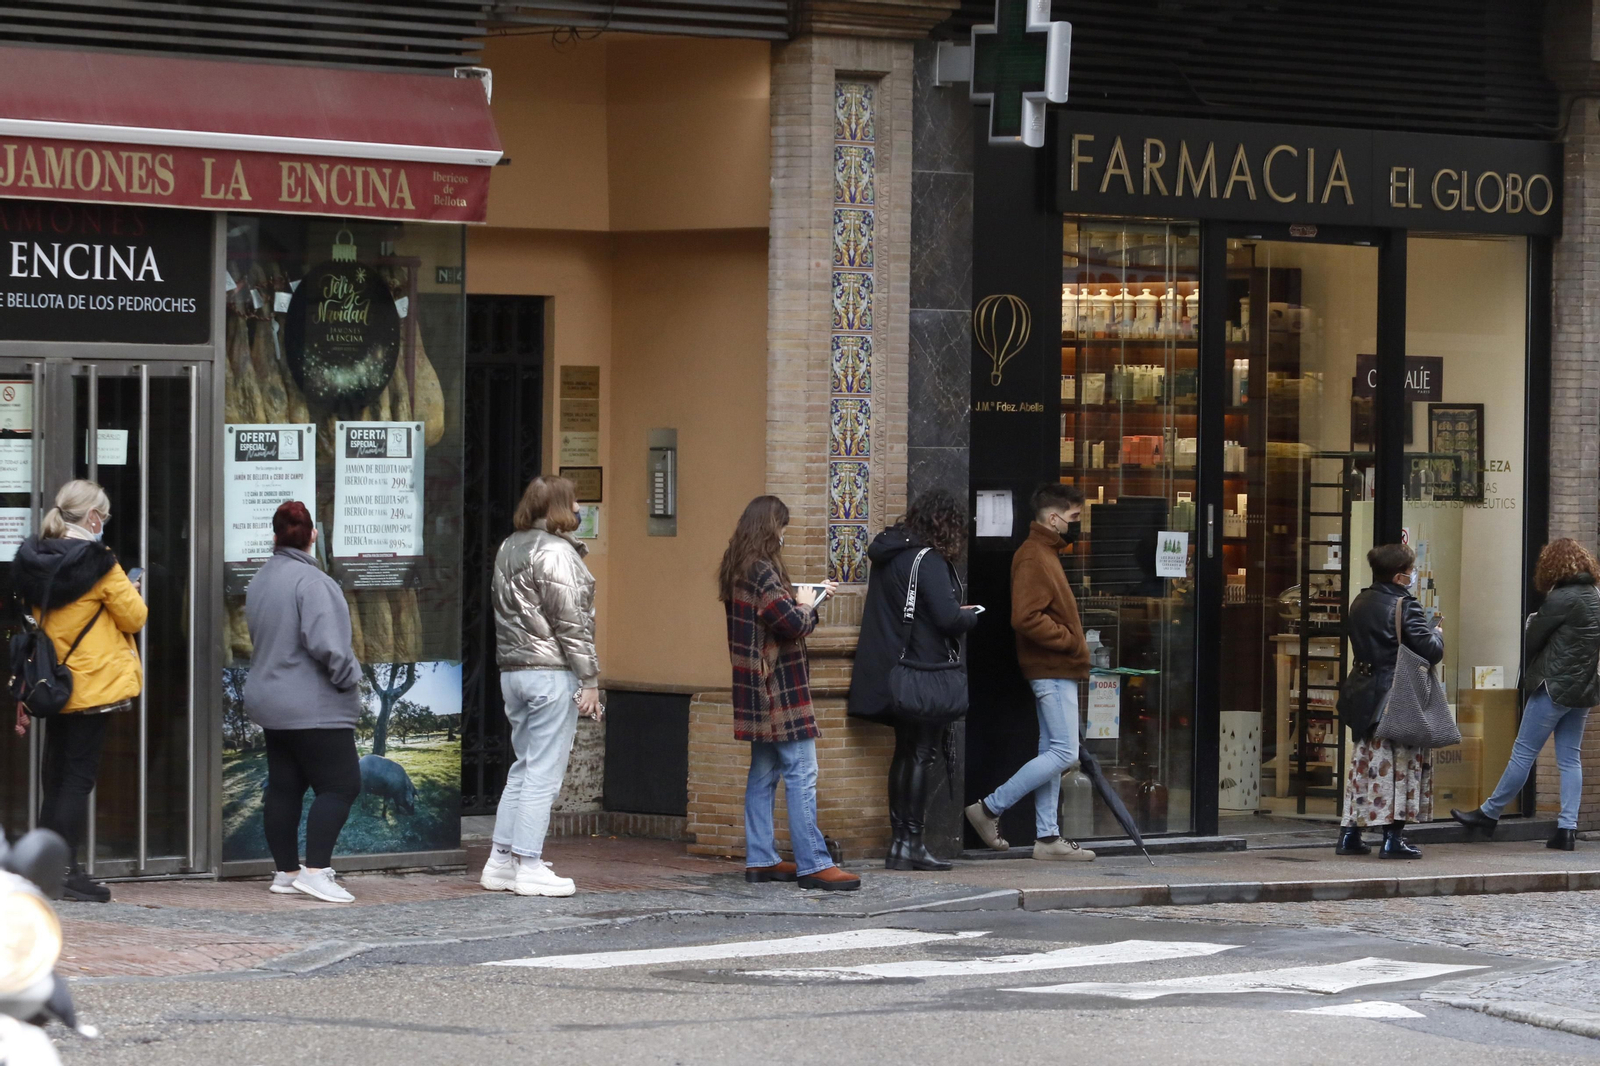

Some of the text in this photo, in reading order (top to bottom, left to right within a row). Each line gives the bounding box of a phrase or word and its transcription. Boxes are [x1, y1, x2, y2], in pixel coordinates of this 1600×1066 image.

[0, 145, 416, 210] JAMONES LA ENCINA
[1071, 134, 1553, 216] FARMACIA EL GLOBO
[443, 185, 455, 195] de
[434, 195, 467, 207] Bellota
[9, 242, 165, 282] ENCINA
[322, 274, 358, 308] Feliz
[8, 293, 64, 309] BELLOTA
[68, 295, 86, 310] DE
[90, 296, 114, 311] LOS
[118, 297, 196, 313] PEDROCHES
[313, 299, 371, 326] Navidad
[1368, 366, 1431, 389] CALÍE
[997, 402, 1018, 412] Fdez.
[1020, 403, 1044, 412] Abella
[240, 433, 277, 443] OFERTA
[351, 430, 386, 440] OFERTA
[366, 465, 373, 473] DE
[375, 465, 397, 473] BELLOTA
[366, 496, 373, 504] DE
[375, 496, 397, 504] BELLOTA
[1408, 498, 1516, 509] REGALA ISDINCEUTICS
[344, 525, 365, 534] PALETA
[366, 525, 380, 533] CEBO
[381, 525, 399, 533] CAMPO
[1097, 690, 1113, 700] LAS
[1436, 750, 1462, 764] ISDIN
